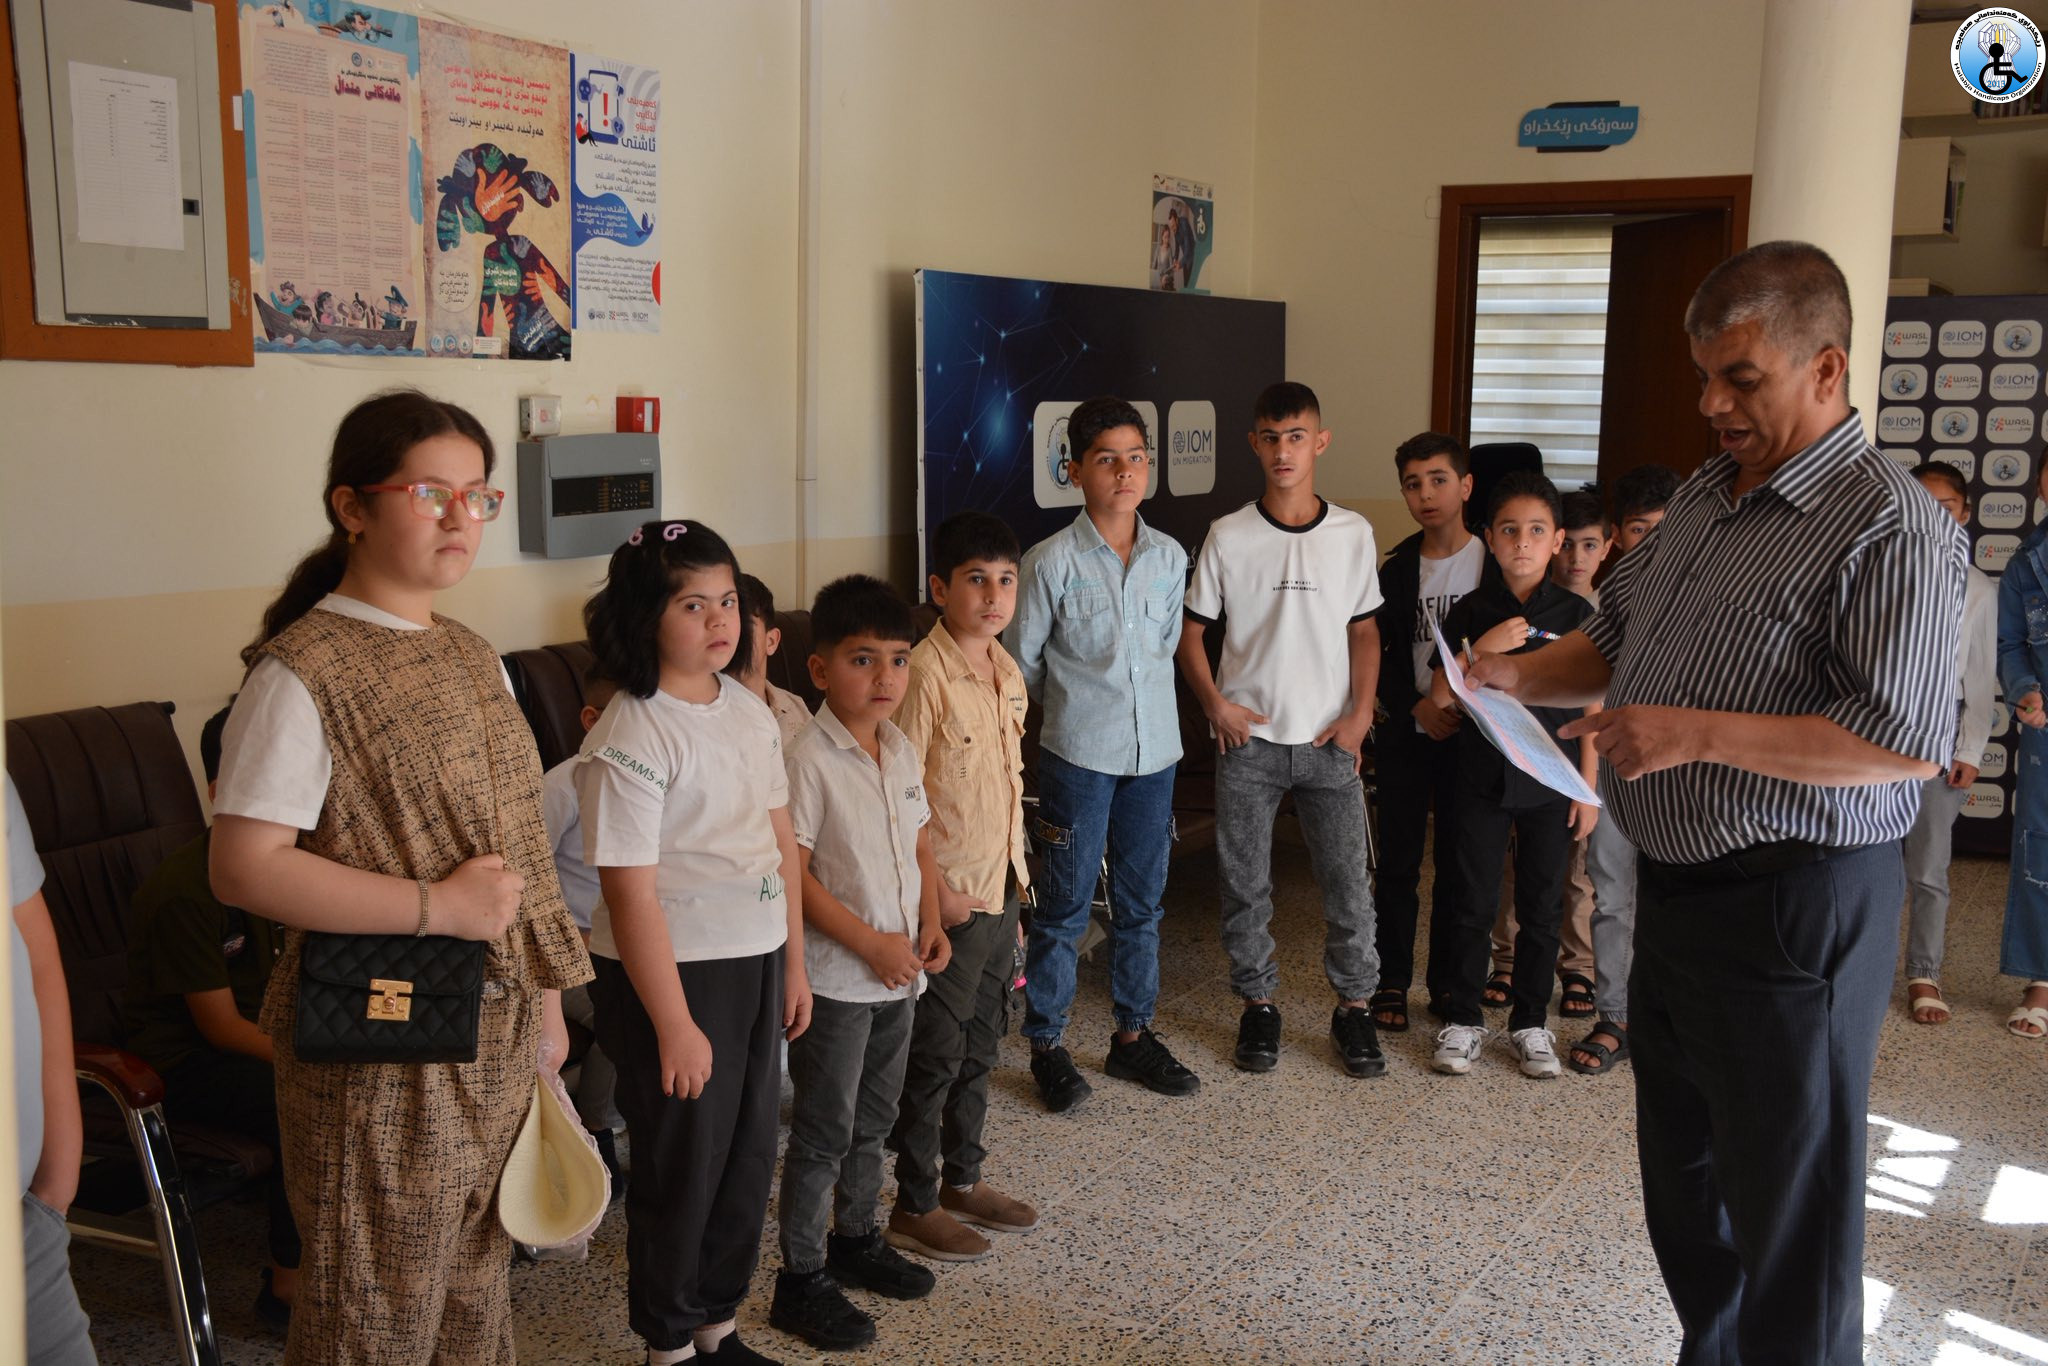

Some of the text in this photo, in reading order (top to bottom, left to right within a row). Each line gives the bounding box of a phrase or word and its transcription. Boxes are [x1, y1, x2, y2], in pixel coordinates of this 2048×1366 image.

[1524, 118, 1634, 139] سەرۆکی ڕێکخراو
[622, 134, 656, 152] ئاشتی
[1902, 332, 1928, 340] WASL
[1957, 331, 1983, 341] IOM
[2008, 375, 2035, 385] IOM
[1896, 416, 1921, 427] IOM
[2004, 418, 2032, 426] WASL
[1187, 430, 1212, 453] IOM
[1173, 455, 1212, 466] UN MIGRATION
[1997, 503, 2023, 513] IOM
[1982, 753, 2003, 763] OM
[603, 746, 656, 781] DREAMS
